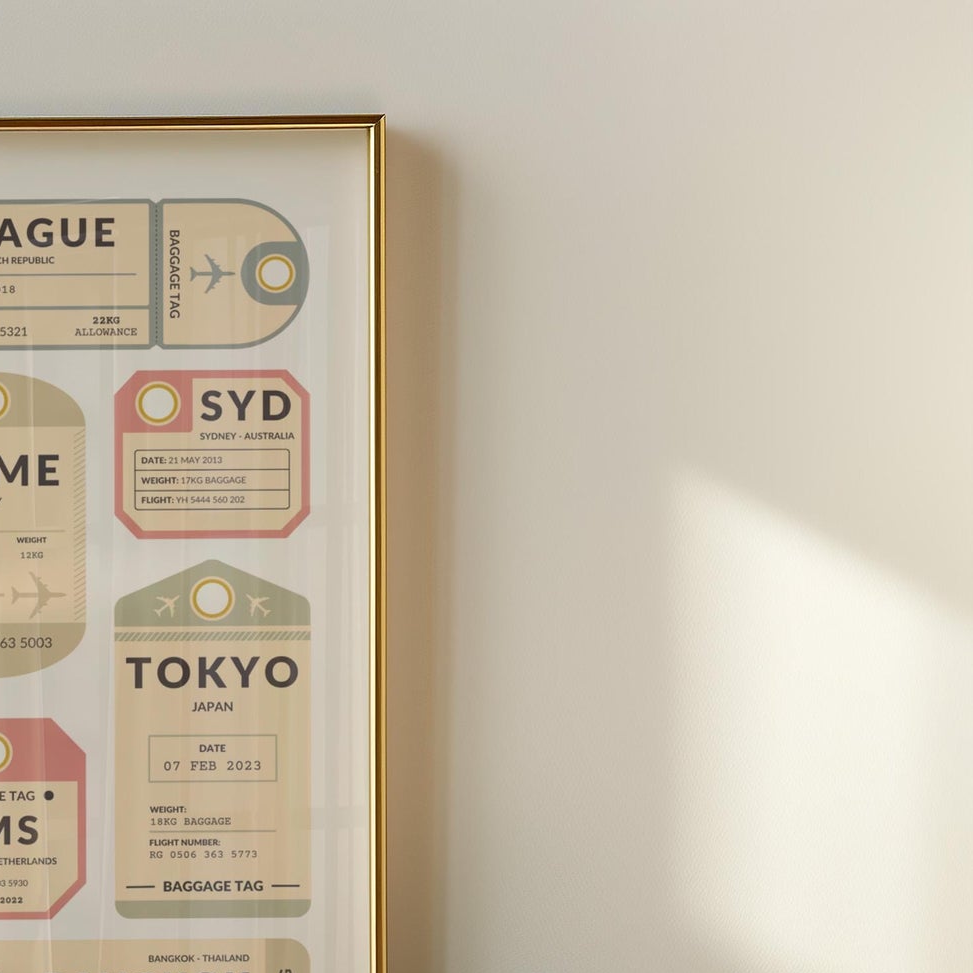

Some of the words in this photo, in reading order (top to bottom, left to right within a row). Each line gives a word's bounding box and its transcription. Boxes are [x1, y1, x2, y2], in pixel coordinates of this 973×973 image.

[11, 256, 55, 264] REPUBLIC
[170, 230, 180, 290] BAGGAGE
[170, 293, 180, 318] TAG
[93, 316, 120, 324] 22KG
[0, 327, 27, 337] 5321
[75, 328, 137, 336] ALLOWANCE
[200, 389, 292, 422] SYD
[200, 432, 236, 440] SYDNEY
[244, 432, 295, 440] AUSTRALIA
[141, 456, 167, 464] DATE:
[202, 456, 222, 464] 2013
[205, 476, 246, 484] BAGGAGE
[141, 496, 174, 504] FLIGHT:
[20, 551, 43, 559] 12KG
[20, 637, 52, 648] 5003
[126, 656, 298, 689] TOKYO
[192, 701, 233, 712] JAPAN
[199, 744, 226, 752] DATE
[164, 761, 180, 771] 07
[190, 761, 217, 771] FEB
[227, 760, 261, 771] 2023
[9, 791, 35, 801] TAG
[151, 818, 177, 826] 18KG
[184, 817, 231, 825] BAGGAGE
[149, 851, 163, 859] RG
[204, 850, 223, 858] 363
[231, 850, 257, 858] 5773
[163, 881, 231, 892] BAGGAGE
[235, 880, 263, 891] TAG
[148, 954, 195, 963] BANGKOK
[202, 954, 250, 962] THAILAND
